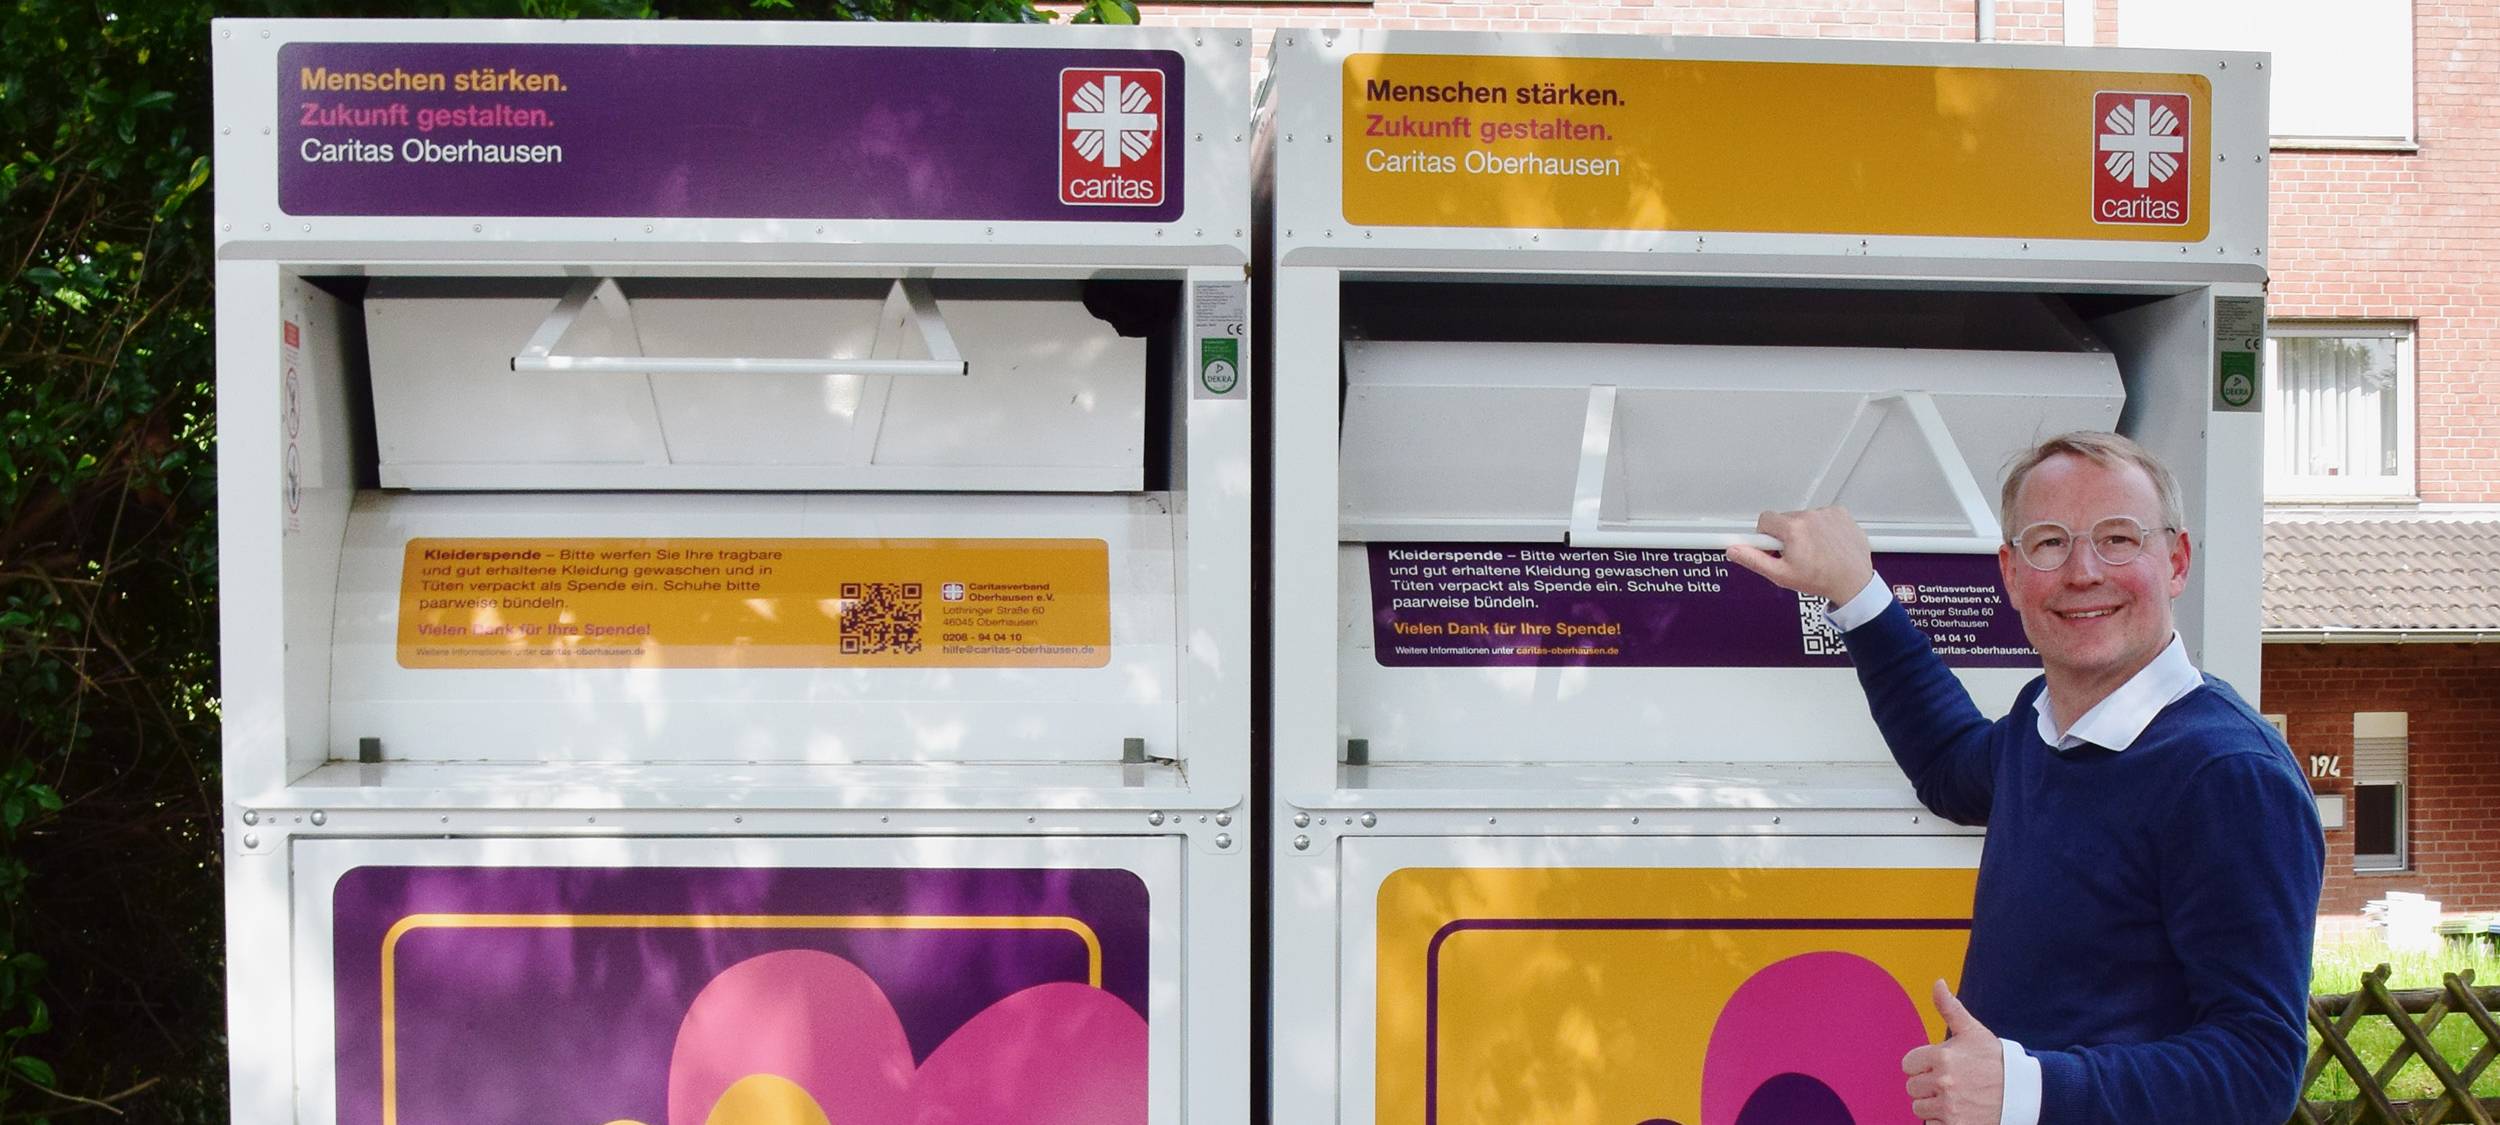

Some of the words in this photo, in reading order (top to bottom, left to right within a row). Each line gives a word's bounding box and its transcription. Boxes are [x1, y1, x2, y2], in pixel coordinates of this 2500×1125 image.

[302, 67, 446, 91] Menschen
[454, 69, 567, 91] stärken.
[1366, 79, 1507, 103] Menschen
[1516, 83, 1625, 106] stärken.
[300, 103, 409, 127] Zukunft
[417, 104, 554, 132] gestalten.
[1366, 114, 1471, 138] Zukunft
[1480, 118, 1612, 143] gestalten.
[301, 138, 394, 162] Caritas
[401, 139, 562, 163] Oberhausen
[1366, 149, 1456, 173] Caritas
[1465, 151, 1620, 176] Oberhausen
[1070, 173, 1154, 199] caritas
[2102, 194, 2180, 219] caritas
[424, 550, 542, 562] Kleiderspende
[560, 550, 595, 560] Bitte
[601, 550, 651, 560] werfen
[656, 550, 680, 560] Sie
[685, 550, 714, 560] Ihre
[719, 550, 782, 563] tragbare
[1388, 550, 1503, 562] Kleiderspende
[1521, 551, 1555, 561] Bitte
[1559, 551, 1609, 561] werfen
[1614, 551, 1637, 562] Sie
[1642, 552, 1669, 562] Ihre
[423, 566, 451, 576] und
[456, 567, 481, 577] gut
[486, 566, 557, 576] erhaltene
[562, 565, 629, 577] Kleidung
[634, 565, 720, 578] gewaschen
[726, 566, 754, 576] und
[760, 566, 773, 576] in
[1390, 566, 1418, 576] und
[1423, 567, 1447, 578] gut
[1452, 566, 1520, 576] erhaltene
[1525, 566, 1590, 578] Kleidung
[1595, 567, 1678, 578] gewaschen
[1683, 567, 1710, 577] und
[1715, 567, 1728, 577] in
[422, 581, 464, 591] Tüten
[470, 580, 535, 593] verpackt
[540, 580, 562, 591] als
[567, 580, 626, 593] Spende
[631, 581, 658, 591] ein.
[663, 580, 722, 591] Schuhe
[727, 580, 761, 591] bitte
[968, 582, 1050, 591] Caritasverband
[1391, 580, 1434, 591] Tüten
[1439, 580, 1503, 593] verpackt
[1508, 581, 1529, 591] als
[1534, 581, 1591, 593] Spende
[1596, 581, 1622, 592] ein.
[1627, 581, 1683, 592] Schuhe
[1687, 582, 1721, 592] bitte
[1918, 585, 1995, 594] Caritasverband
[419, 598, 498, 610] paarweise
[503, 596, 569, 609] bündeln.
[968, 593, 1033, 601] Oberhausen
[1036, 593, 1055, 601] e.V.
[1393, 598, 1470, 610] paarweise
[1474, 597, 1539, 608] bündeln.
[1920, 595, 1981, 604] Oberhausen
[1984, 595, 2002, 604] e.V.
[943, 606, 992, 616] Lothringer
[997, 606, 1029, 614] Straße
[1032, 606, 1044, 614] 60
[1905, 608, 1945, 617] thringer
[1948, 607, 1979, 616] Straße
[1982, 607, 1994, 616] 60
[943, 618, 973, 626] 46045
[976, 618, 1038, 626] Oberhausen
[1931, 619, 1989, 628] Oberhausen
[418, 624, 466, 635] Vielen
[519, 624, 542, 635] für
[548, 624, 578, 635] Ihre
[584, 623, 651, 637] Spende!
[1394, 622, 1443, 635] Vielen
[1448, 622, 1489, 635] Dank
[1494, 622, 1516, 635] für
[1521, 623, 1552, 635] Ihre
[1556, 623, 1621, 637] Spende!
[942, 633, 968, 641] 0208
[978, 633, 990, 641] 94
[994, 633, 1006, 641] 04
[1011, 633, 1022, 641] 10
[1934, 633, 1946, 642] 94
[1949, 634, 1961, 642] 04
[1964, 634, 1976, 642] 10
[943, 645, 1095, 655] hilfe@caritas-oberhausen.de
[1395, 646, 1428, 655] Weitere
[1430, 646, 1489, 655] Informationen
[1491, 647, 1514, 655] unter
[1516, 646, 1619, 655] caritas-oberhausen.de
[2310, 755, 2340, 777] 194
